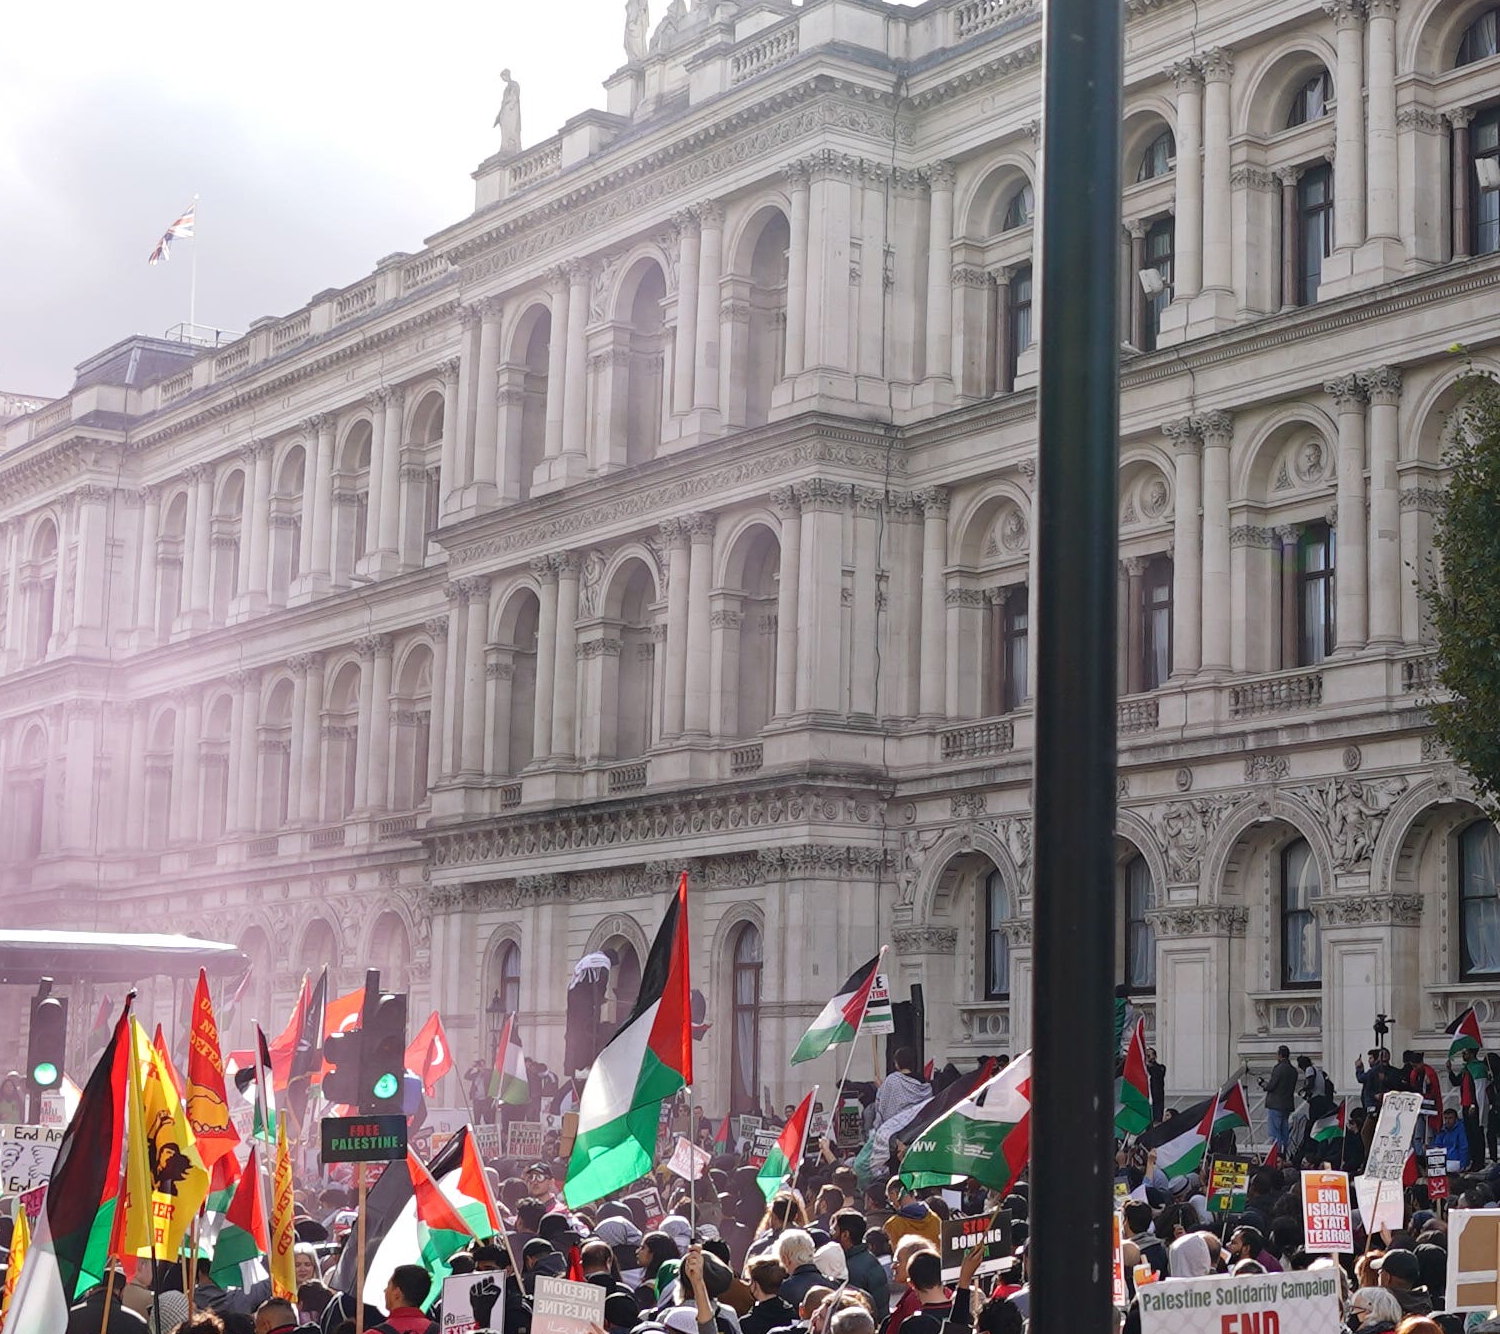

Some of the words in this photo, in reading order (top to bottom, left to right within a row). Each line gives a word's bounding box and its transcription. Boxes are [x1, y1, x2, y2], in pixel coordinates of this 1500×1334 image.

[14, 1126, 39, 1141] End
[349, 1124, 380, 1137] FREE
[1317, 1188, 1341, 1204] END
[1307, 1202, 1349, 1218] ISRAELI
[1313, 1216, 1347, 1231] STATE
[1308, 1228, 1351, 1245] TERROR
[1142, 1288, 1212, 1313] Palestine
[1217, 1281, 1278, 1309] Solidarity
[1281, 1276, 1337, 1305] Campaign
